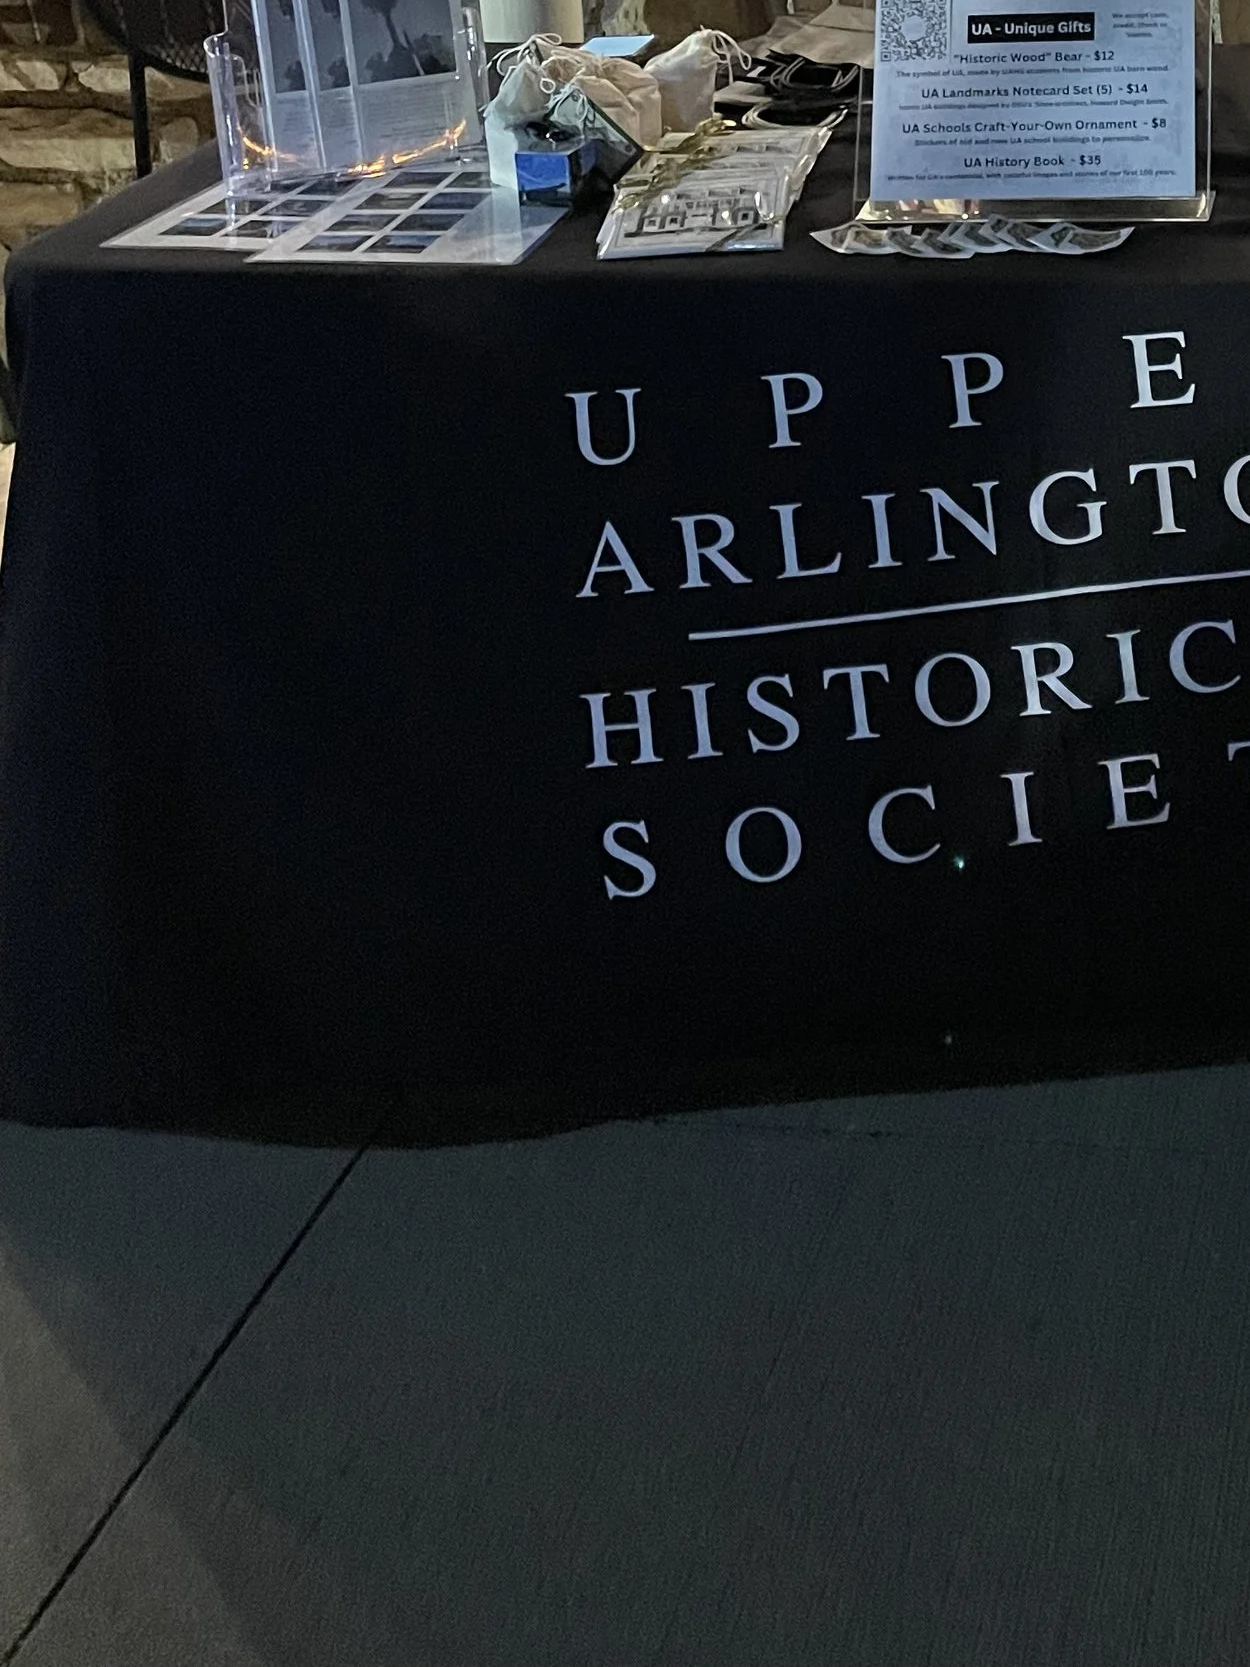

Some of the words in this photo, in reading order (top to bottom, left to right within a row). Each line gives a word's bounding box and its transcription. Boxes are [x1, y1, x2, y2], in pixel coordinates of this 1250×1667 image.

[971, 23, 992, 36] UA
[1004, 21, 1054, 38] Unique
[1057, 20, 1092, 34] Gifts
[954, 53, 1008, 64] "Historic
[1010, 52, 1052, 64] Wood"
[1055, 51, 1083, 62] Bear
[1093, 50, 1115, 62] $12
[921, 88, 939, 98] UA
[942, 86, 1009, 98] Landmarks
[1013, 85, 1069, 97] Notecard
[1073, 84, 1093, 95] Set
[1096, 84, 1112, 96] (5)
[1126, 83, 1148, 95] $14
[902, 123, 919, 134] UA
[923, 122, 971, 133] Schools
[974, 119, 1072, 133] Craft-Your-Own
[1075, 119, 1138, 130] Ornament
[1151, 117, 1167, 130] $8
[963, 157, 982, 168] UA
[985, 156, 1030, 169] History
[1034, 155, 1065, 167] Book
[1079, 154, 1102, 166] $35
